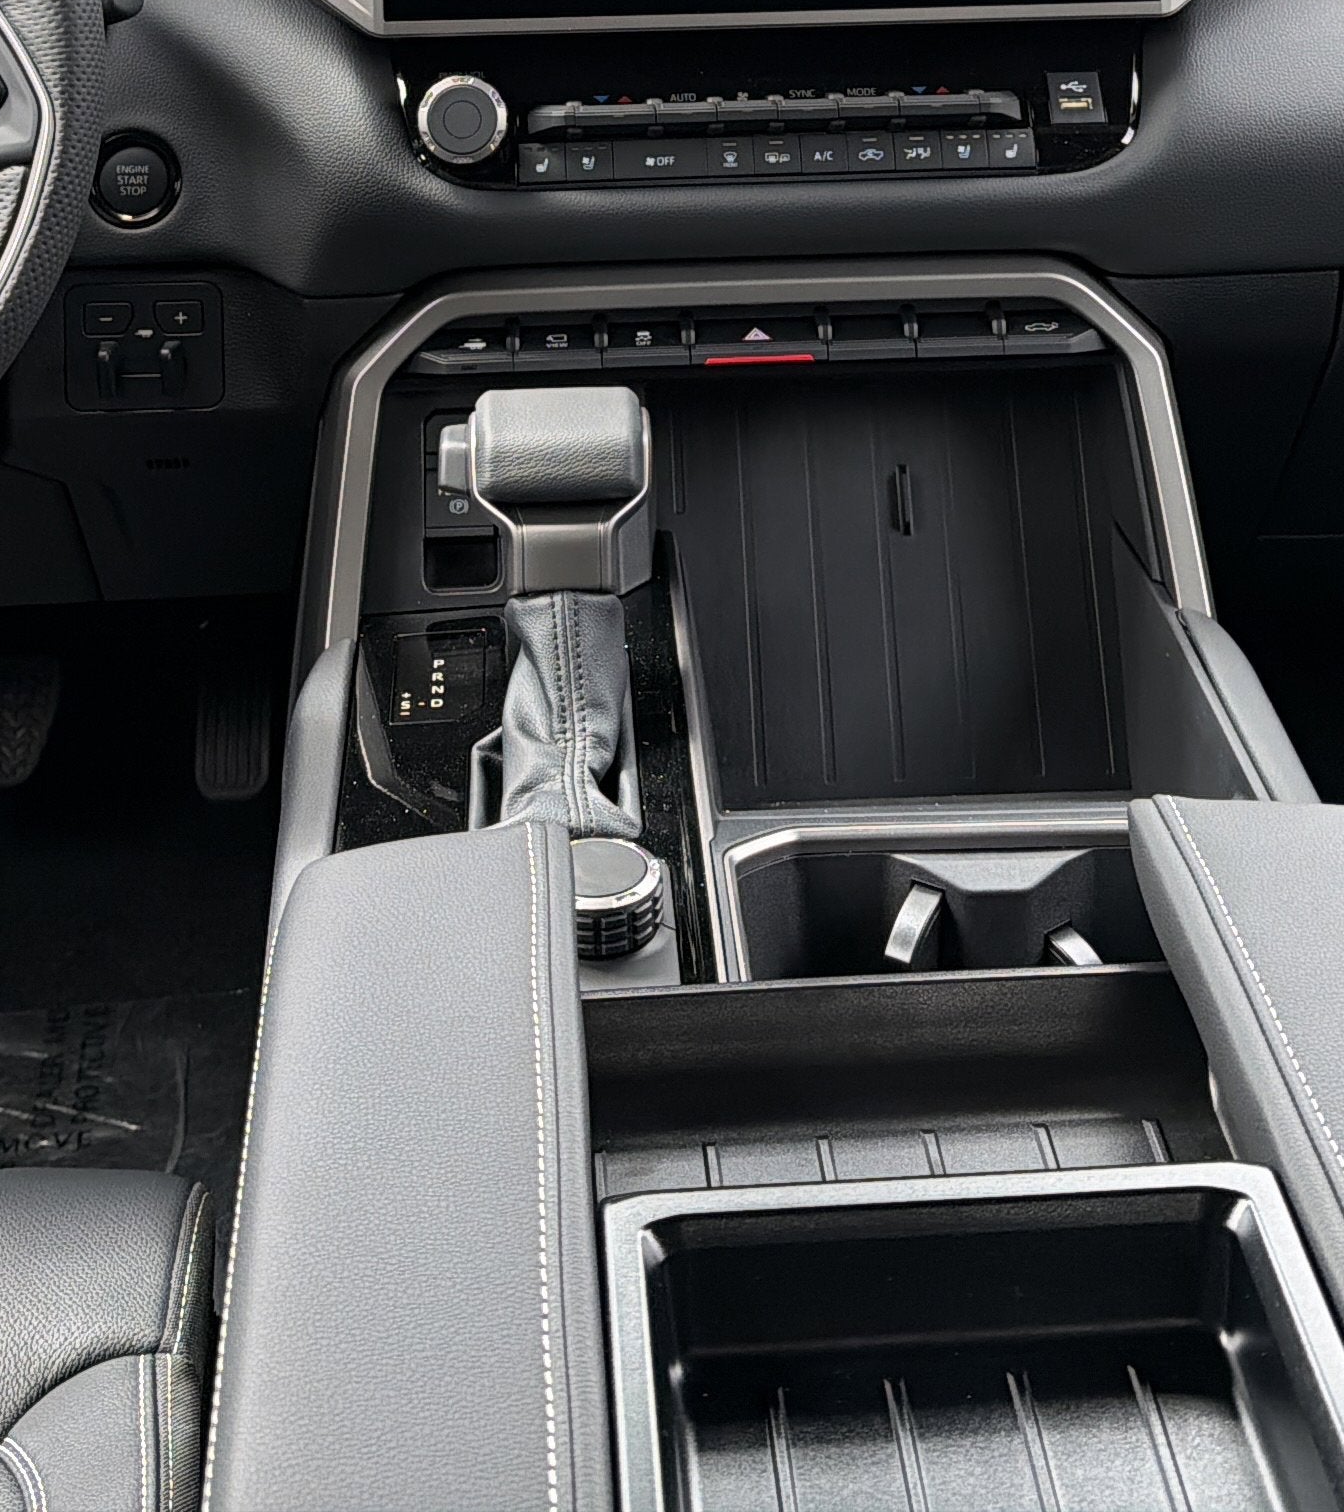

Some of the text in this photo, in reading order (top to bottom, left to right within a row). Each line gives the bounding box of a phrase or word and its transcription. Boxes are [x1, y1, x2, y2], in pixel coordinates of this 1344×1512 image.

[789, 89, 817, 98] SYNC
[847, 87, 878, 97] MODE
[669, 93, 697, 102] AUTO
[656, 156, 675, 166] OFF
[813, 151, 834, 161] A/C
[116, 165, 149, 174] ENGINE
[117, 175, 149, 185] START
[119, 186, 147, 196] STOP
[433, 659, 445, 668] P
[431, 672, 444, 681] R
[431, 685, 445, 694] N
[400, 700, 411, 710] S
[430, 698, 444, 708] D
